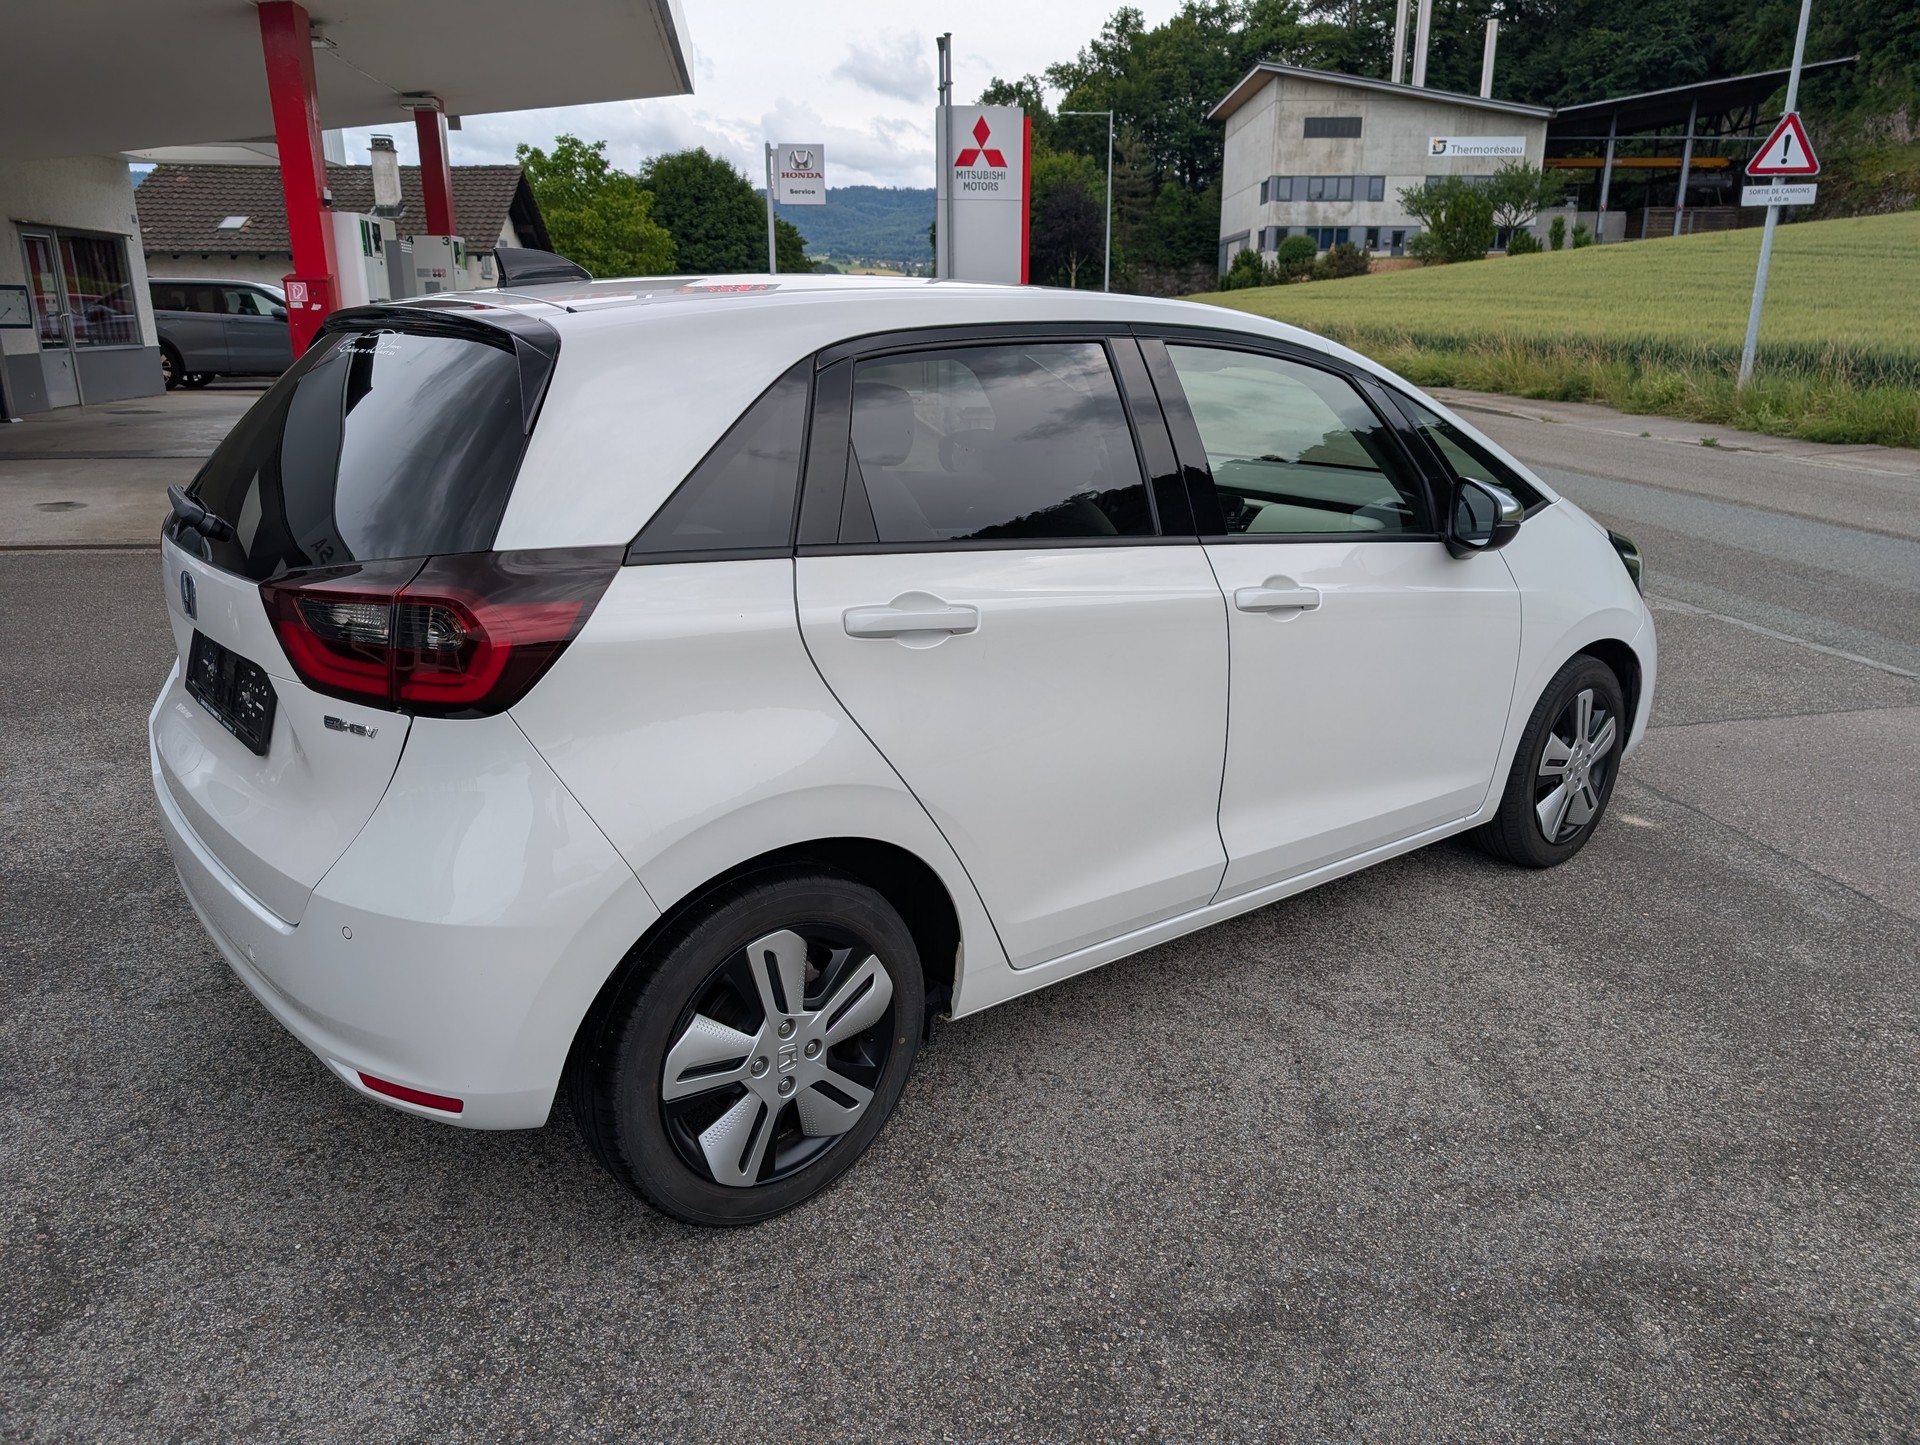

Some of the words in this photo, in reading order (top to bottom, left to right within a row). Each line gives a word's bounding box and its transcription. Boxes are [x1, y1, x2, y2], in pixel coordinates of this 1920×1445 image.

[1451, 144, 1523, 154] Thermoréseau
[956, 170, 1006, 180] MITSUBISHI
[963, 181, 999, 191] MOTORS
[1781, 187, 1810, 195] CAMIONS
[406, 235, 414, 245] 4
[442, 236, 450, 246] 3
